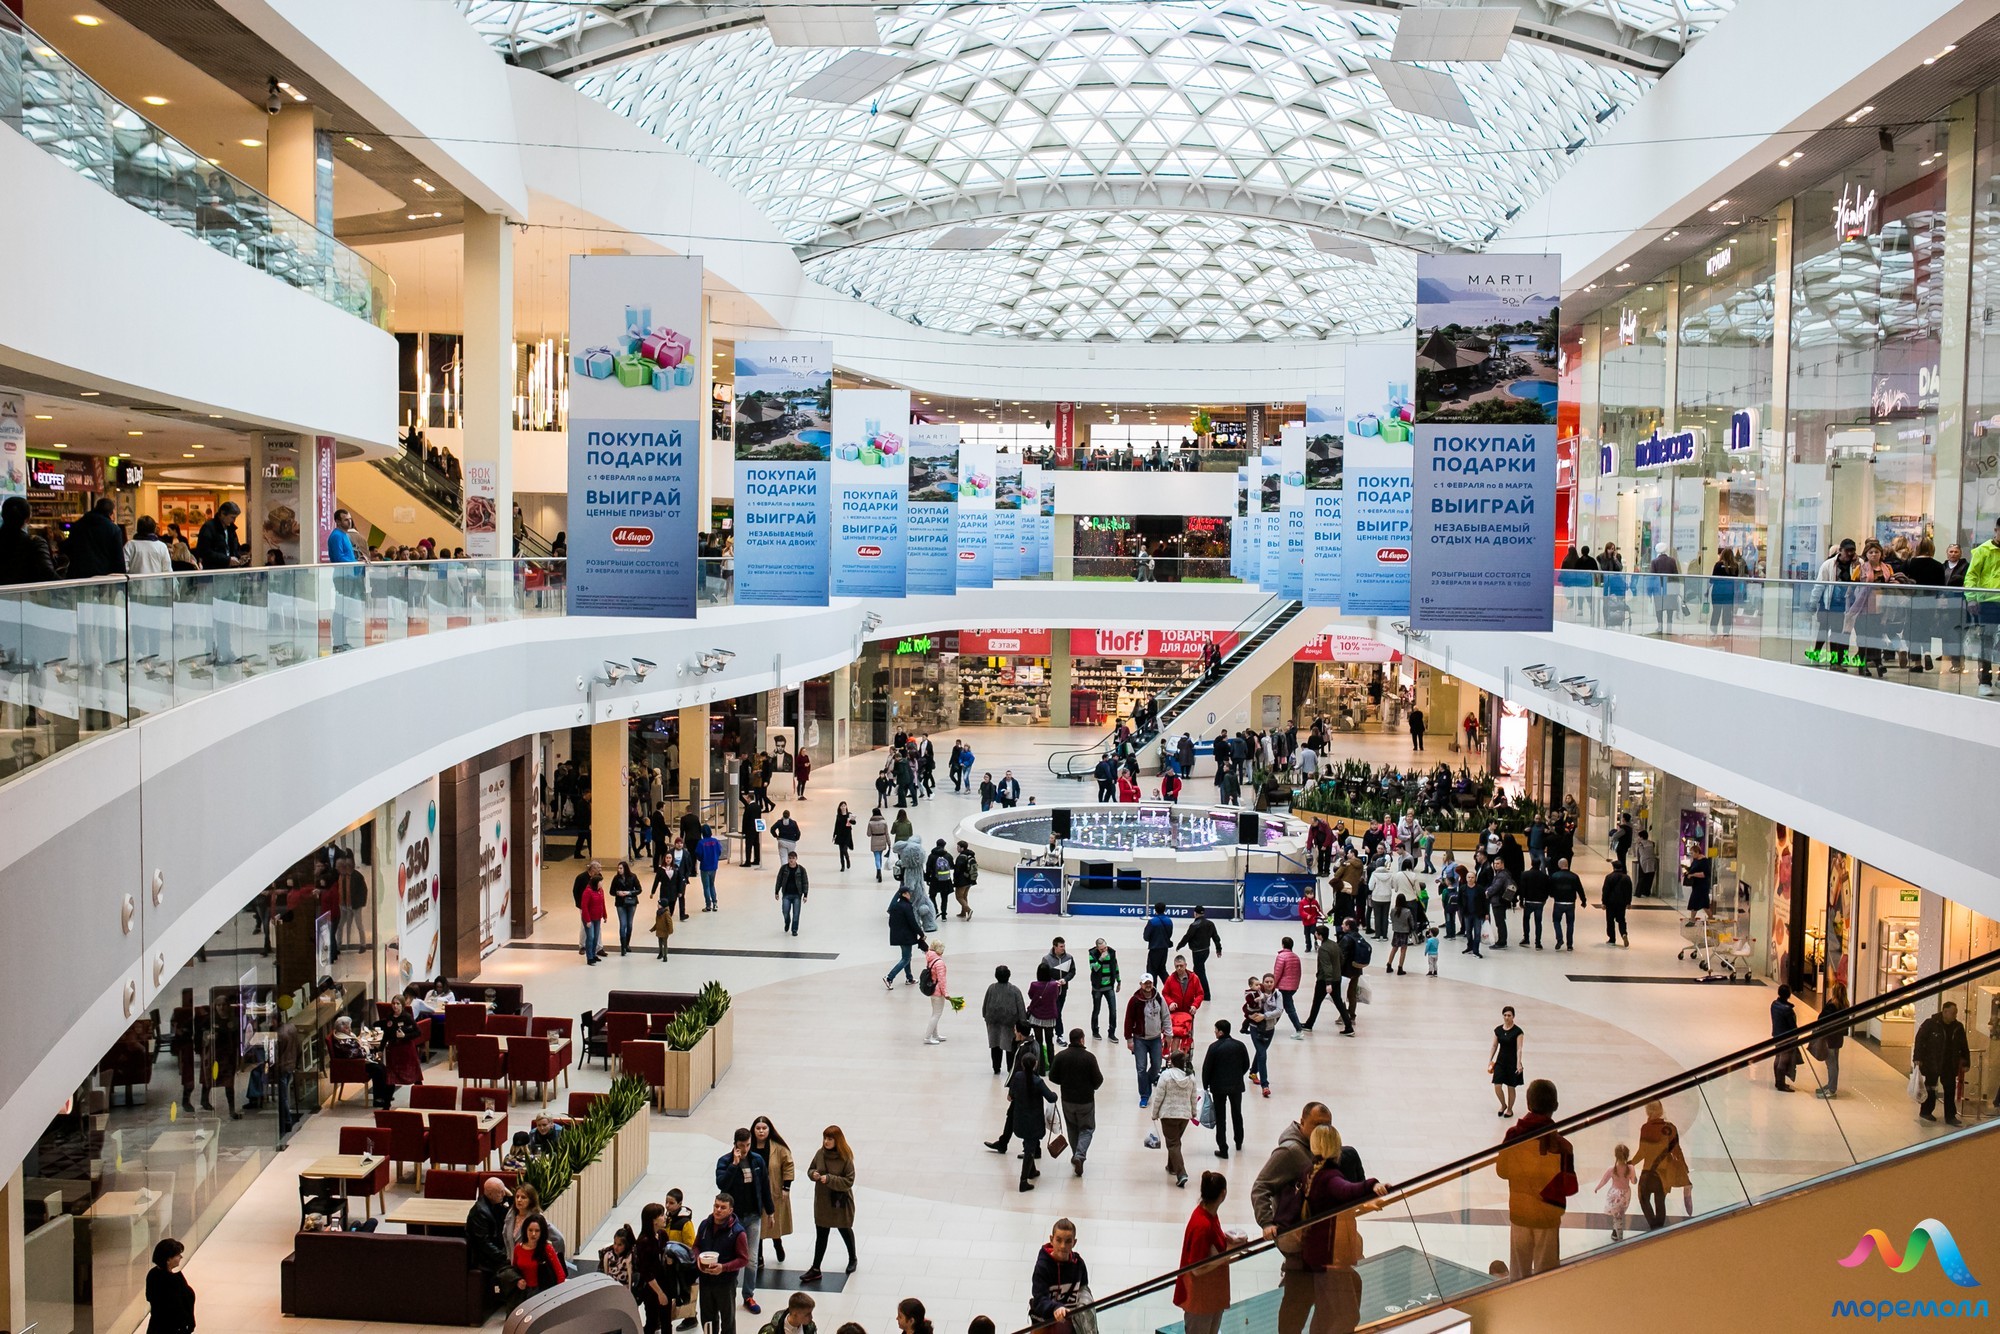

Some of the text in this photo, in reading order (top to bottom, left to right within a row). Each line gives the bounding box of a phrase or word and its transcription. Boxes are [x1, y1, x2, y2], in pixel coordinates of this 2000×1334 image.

[1706, 247, 1730, 276] ИГРУШКИ
[1468, 275, 1532, 285] MARTI
[1919, 364, 1940, 397] DA
[588, 429, 682, 447] ПОКУПАЙ
[1434, 434, 1535, 452] ПОКУПАЙ
[1635, 431, 1693, 469] mothercare
[587, 451, 682, 468] ПОДАРКИ
[1976, 454, 2000, 474] ne
[1433, 457, 1535, 475] ПОДАРКИ
[471, 468, 490, 478] ВОК
[747, 468, 816, 481] ПОКУПАЙ
[1358, 477, 1413, 488] ПОКУП
[747, 484, 817, 497] ПОДАРКИ
[843, 490, 898, 500] ПОКУПАЙ
[587, 488, 680, 505] ВЫИГРАЙ
[1316, 497, 1342, 506] ПОК
[1358, 491, 1411, 504] ПОДАР
[843, 502, 898, 512] ПОДАРКИ
[1432, 495, 1534, 514] ВЫИГРАЙ
[586, 509, 626, 517] ЦЕННЫЕ
[668, 510, 680, 518] ОТ
[746, 511, 816, 524] ВЫИГРАЙ
[1315, 509, 1341, 518] ПОД
[842, 524, 897, 534] ВЫИГРАЙ
[1357, 521, 1412, 532] ВЫИГР
[1434, 523, 1530, 533] НЕЗАБЫВАЕМЫЙ
[907, 534, 949, 543] ЫИГРАЙ
[1315, 532, 1341, 540] ВЫИ
[1431, 535, 1471, 545] ОТДЫХ
[1475, 536, 1490, 544] НА
[1160, 630, 1214, 642] ТОВАРЫ
[1160, 643, 1206, 654] ДЛЯ ДОМ
[1339, 642, 1360, 651] 10%
[406, 836, 429, 879] 350
[408, 878, 427, 902] ВИДОВ
[1253, 895, 1303, 903] КИБЕРМИ
[406, 897, 430, 926] КОНФЕТ
[1119, 907, 1188, 915] КИБМИР
